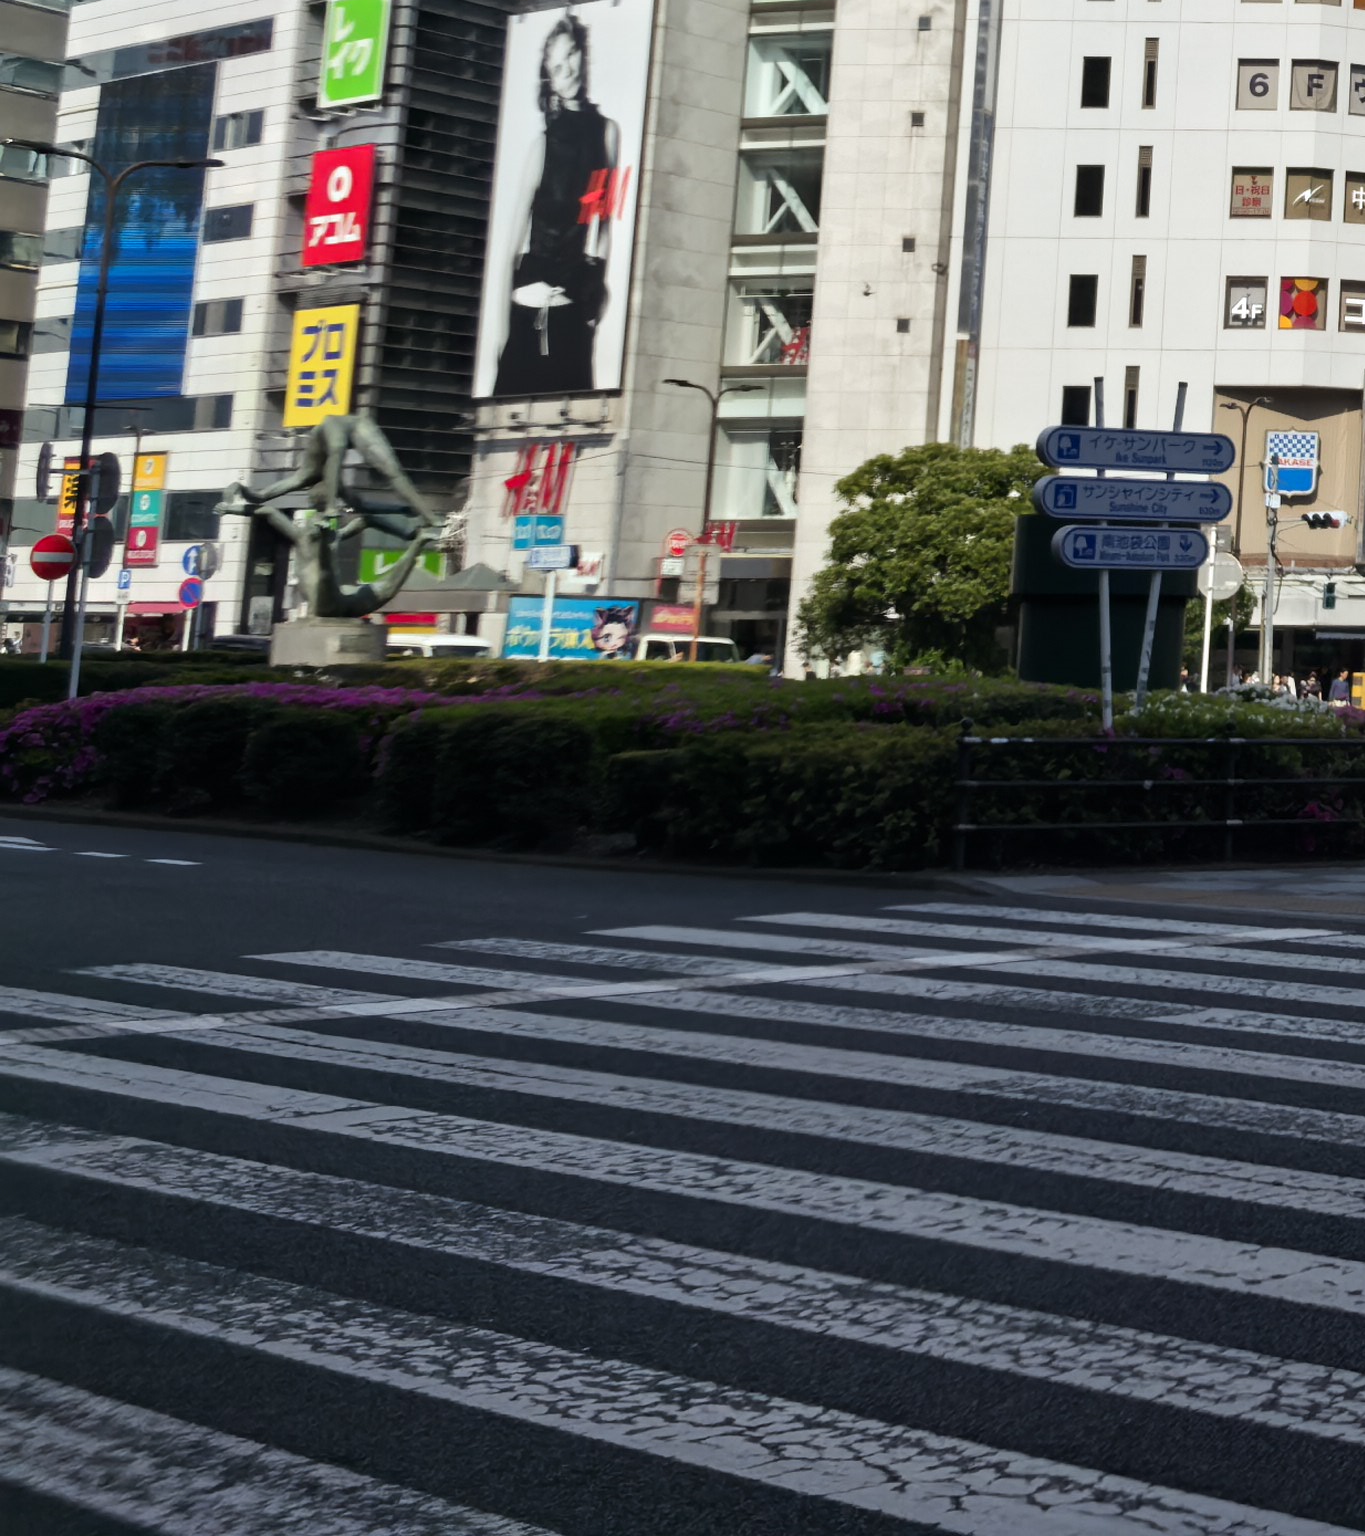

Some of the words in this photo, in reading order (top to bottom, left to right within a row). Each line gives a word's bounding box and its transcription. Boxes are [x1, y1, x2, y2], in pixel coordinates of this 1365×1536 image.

[308, 216, 361, 247] アコム
[1230, 296, 1263, 322] 4F
[300, 322, 344, 363] プロ
[295, 367, 339, 408] ミス
[1115, 452, 1128, 462] Ike
[1083, 485, 1195, 503] サンシャインシティ
[1109, 501, 1148, 513] Sunshine
[1152, 503, 1167, 515] City
[1102, 535, 1170, 550] 南池袋公園
[121, 572, 130, 588] P
